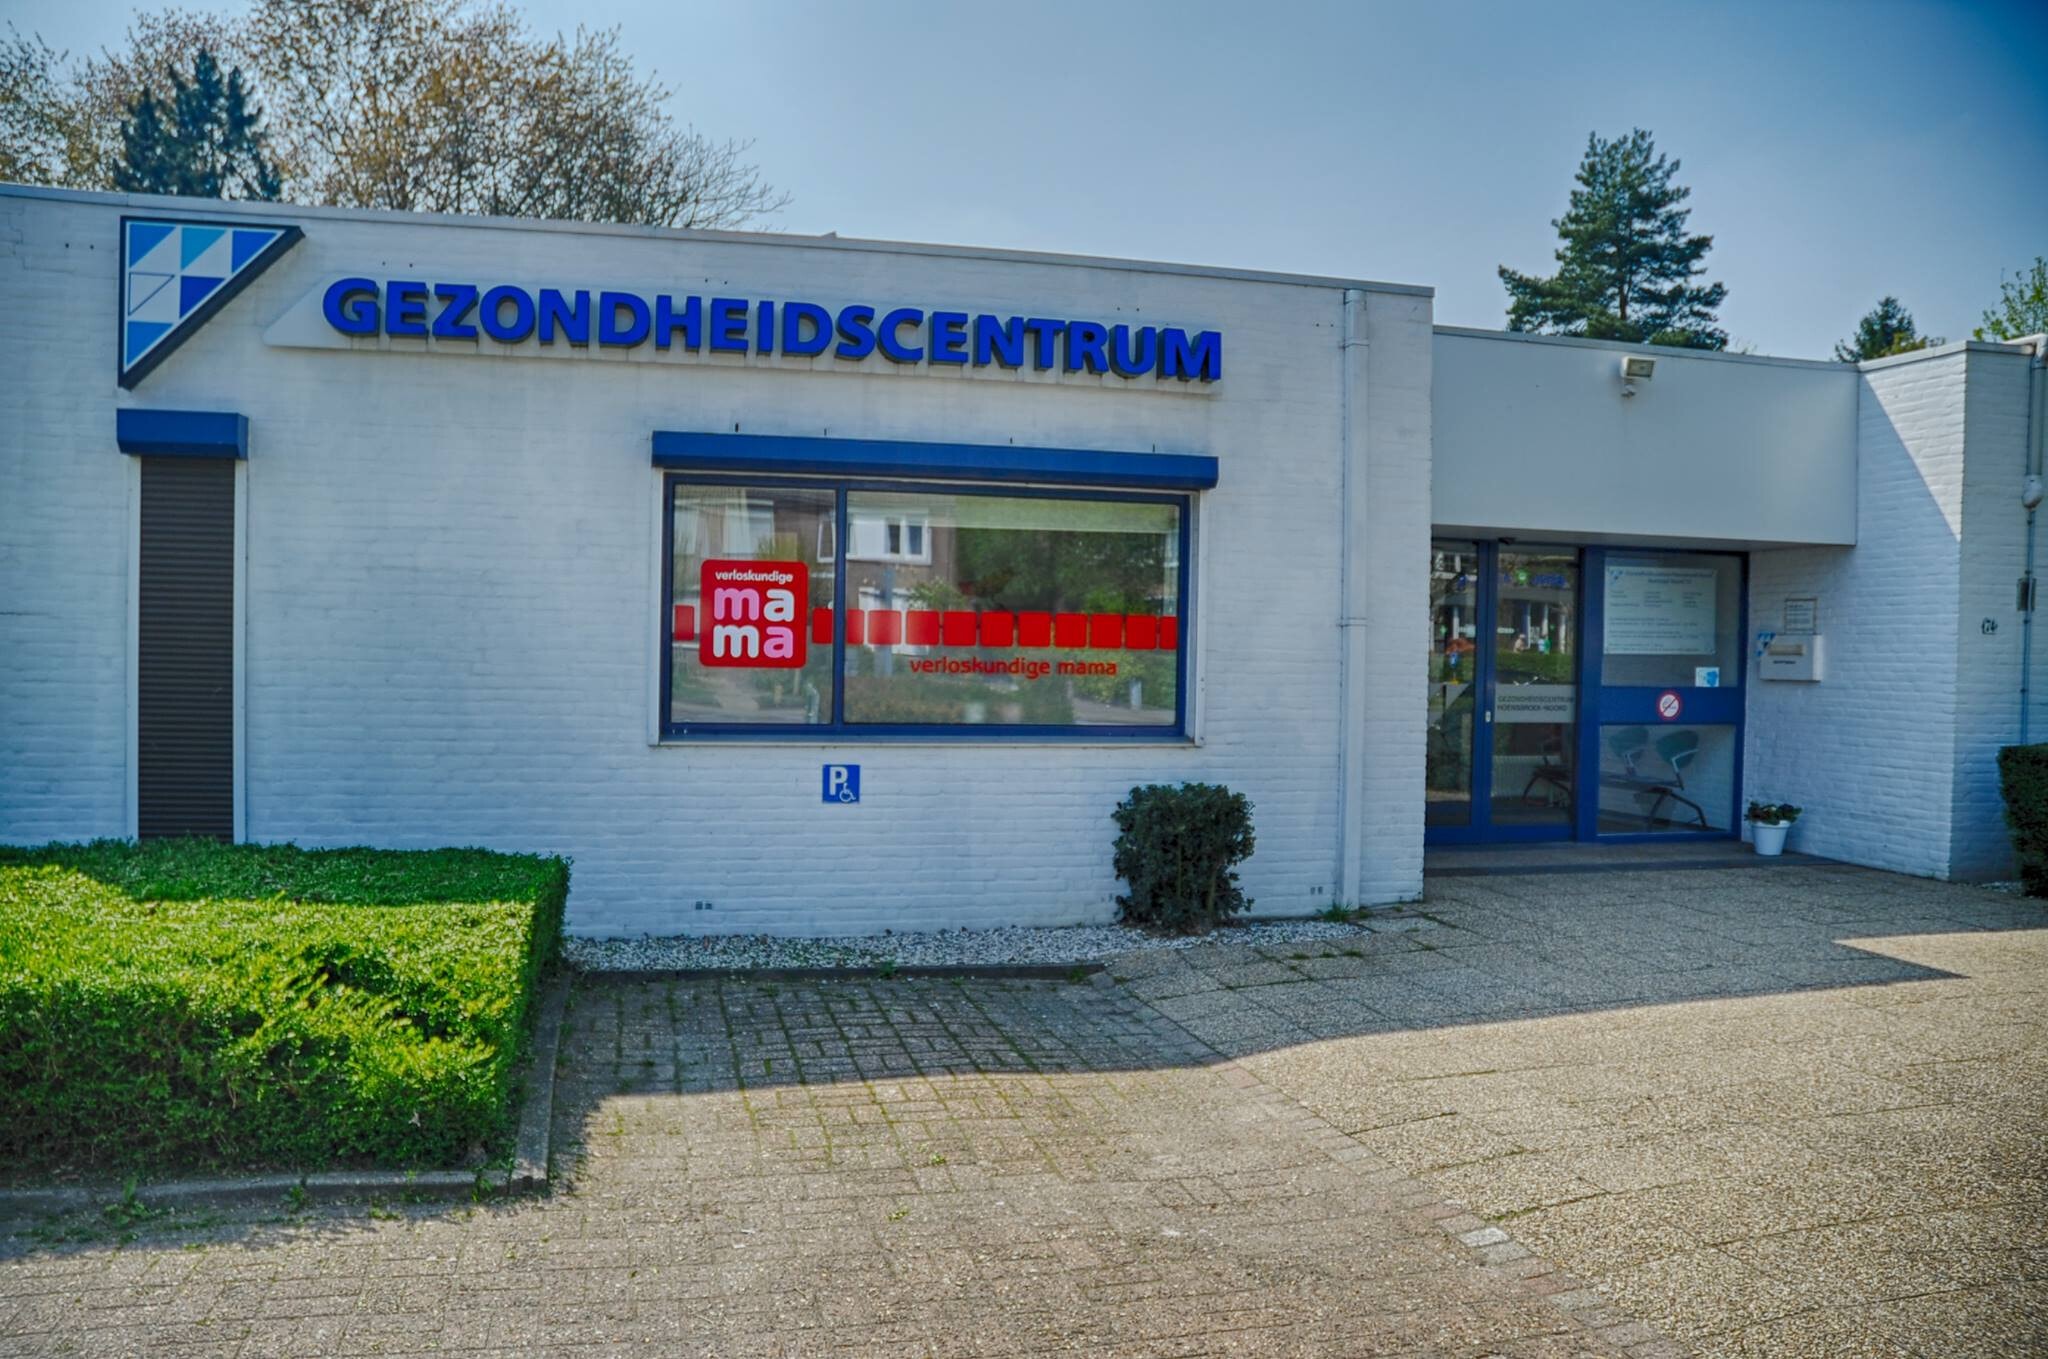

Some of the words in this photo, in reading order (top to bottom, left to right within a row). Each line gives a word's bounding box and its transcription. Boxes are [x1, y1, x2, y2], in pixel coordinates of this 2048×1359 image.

[322, 277, 1222, 382] GEZONDHEIDSCENTRUM
[715, 569, 794, 585] verloskundige
[910, 656, 1050, 680] verloskundige
[1056, 659, 1118, 676] mama
[830, 766, 848, 796] P
